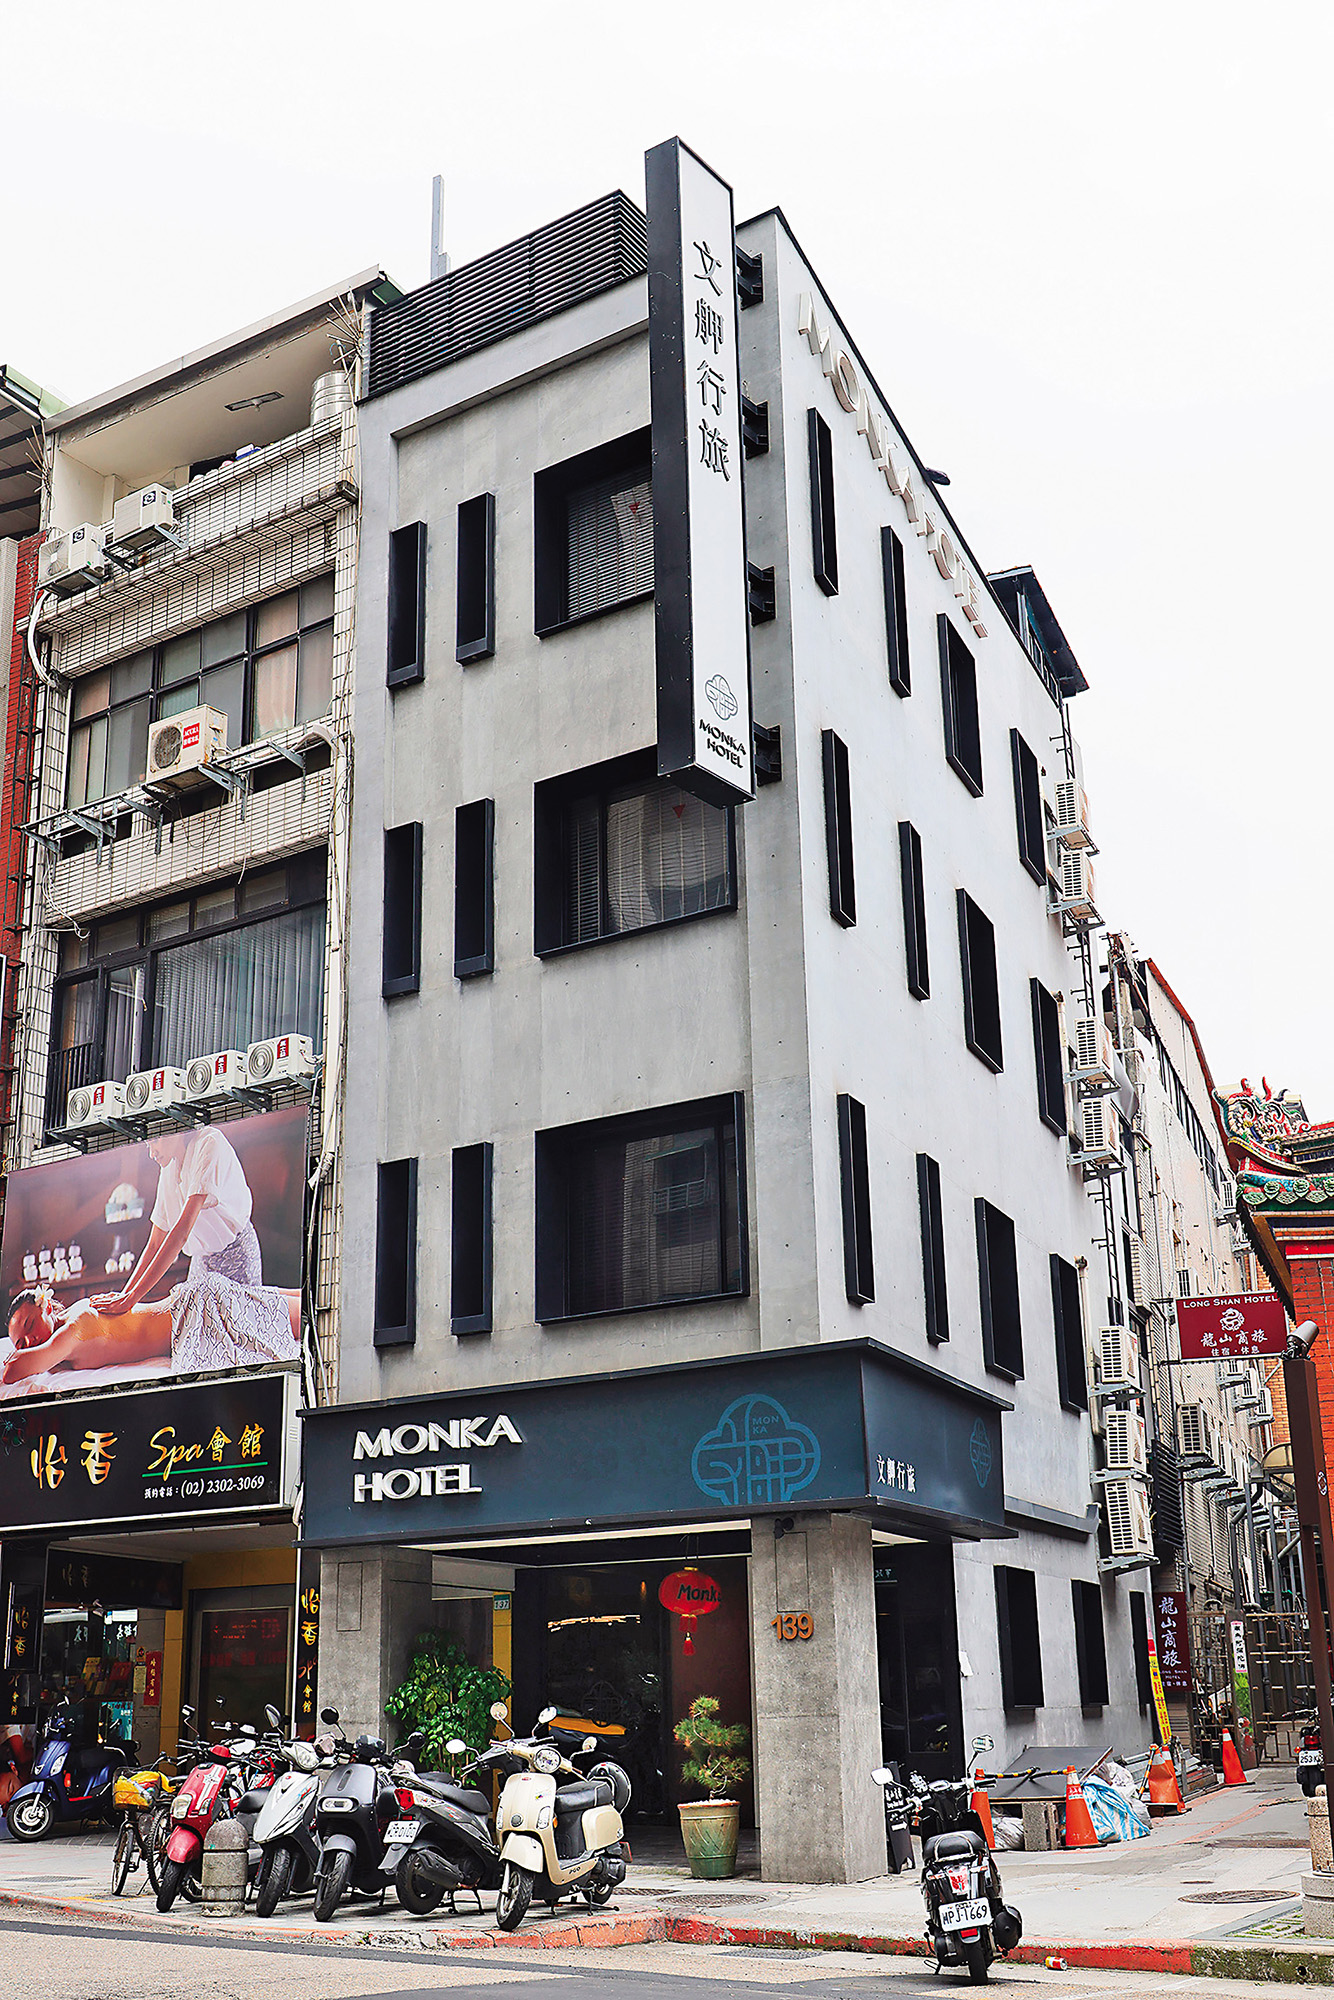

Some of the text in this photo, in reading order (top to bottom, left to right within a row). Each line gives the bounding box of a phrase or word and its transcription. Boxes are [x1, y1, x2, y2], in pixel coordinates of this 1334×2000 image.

[693, 240, 731, 483] 文舺行旅
[798, 290, 919, 523] MONKA
[699, 718, 747, 756] MONKA
[706, 737, 744, 769] HOTEL
[1183, 1295, 1278, 1309] LONG SHAN HOTEL
[1201, 1328, 1268, 1347] 龍山商旅
[353, 1414, 523, 1460] MONKA
[752, 1415, 779, 1426] MON
[752, 1426, 768, 1435] KA
[31, 1430, 118, 1490] 怡香
[181, 1479, 204, 1498] (02)
[206, 1475, 265, 1494] 2302-3069
[354, 1463, 483, 1503] HOTEL
[301, 1588, 319, 1646] 怡香
[771, 1612, 814, 1641] 139
[1158, 1596, 1181, 1667] 龍山商旅
